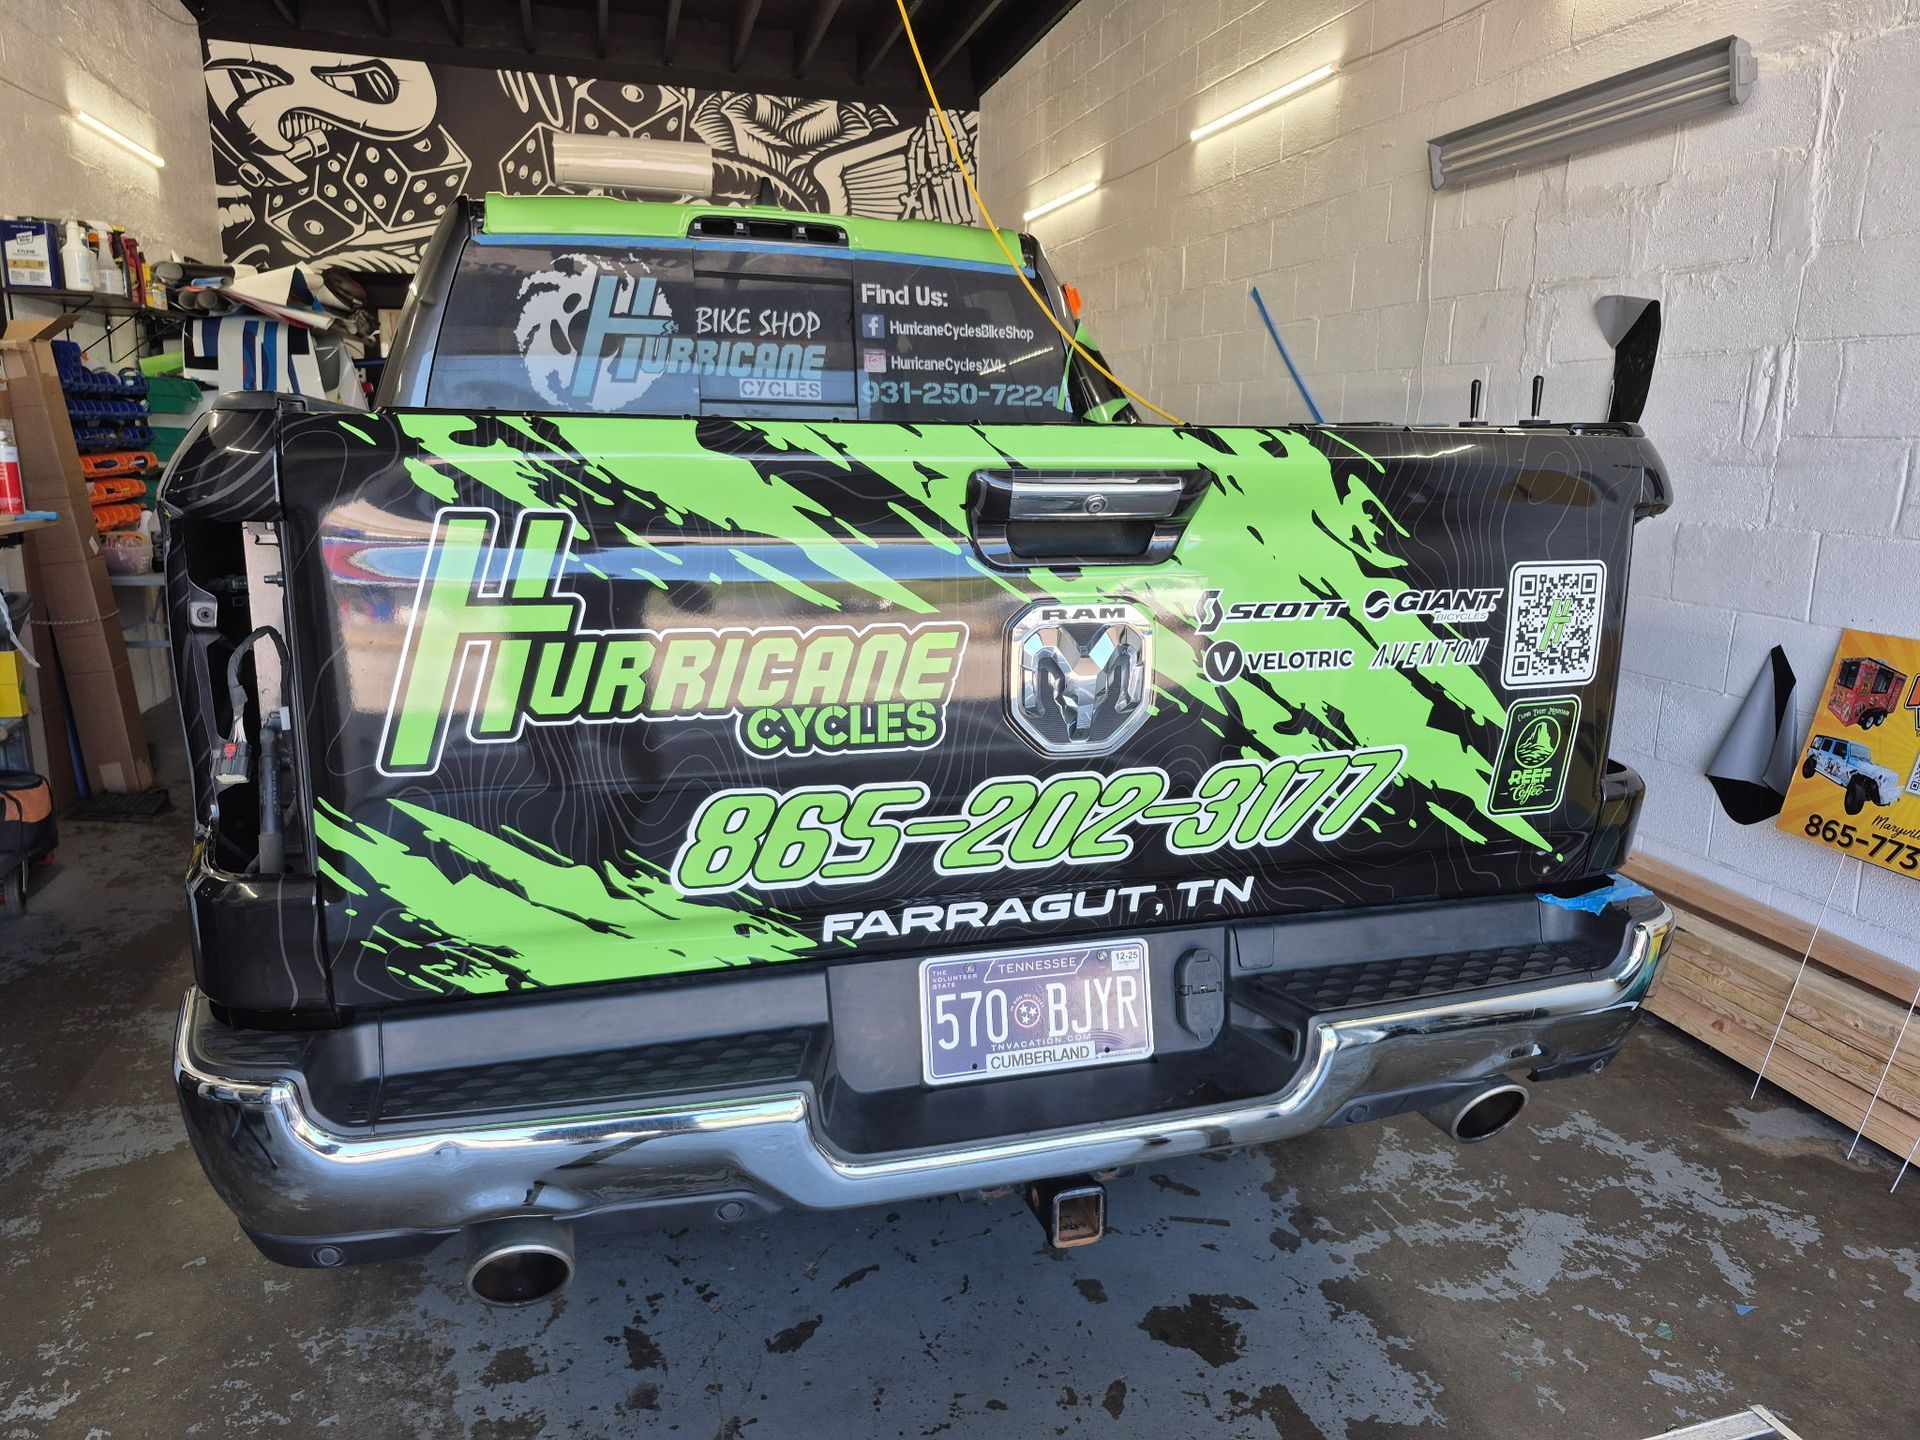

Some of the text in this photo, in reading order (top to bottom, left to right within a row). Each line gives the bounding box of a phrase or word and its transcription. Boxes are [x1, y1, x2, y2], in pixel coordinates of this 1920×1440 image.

[861, 283, 948, 307] Find Us:
[695, 307, 821, 339] BIKE SHOP
[889, 320, 1034, 342] HurricaneCyclesBikeShop
[741, 380, 820, 398] CYCLES
[864, 381, 1059, 408] 931-250-7224
[1226, 601, 1347, 620] SCOTT
[1393, 589, 1504, 612] GIANT
[1041, 607, 1126, 621] RAM
[1435, 612, 1488, 622] BICYCLES
[1248, 650, 1353, 671] VELOTRIC
[1371, 638, 1489, 668] AVENTON
[745, 701, 943, 751] CYCLES
[1508, 768, 1553, 785] REEF
[1511, 783, 1545, 805] Coffee
[673, 746, 1406, 893] 865-202-3177
[821, 875, 1255, 943] FARRAGUT, TN
[998, 957, 1077, 974] TENNESSEE
[1115, 951, 1138, 960] 12-25
[932, 973, 978, 983] VOLUNTEER
[932, 982, 956, 990] STATE
[935, 975, 1139, 1050] 570 BJYR
[991, 1034, 1092, 1052] TNVACATION.COM
[990, 1045, 1090, 1071] CUMBERLAND
